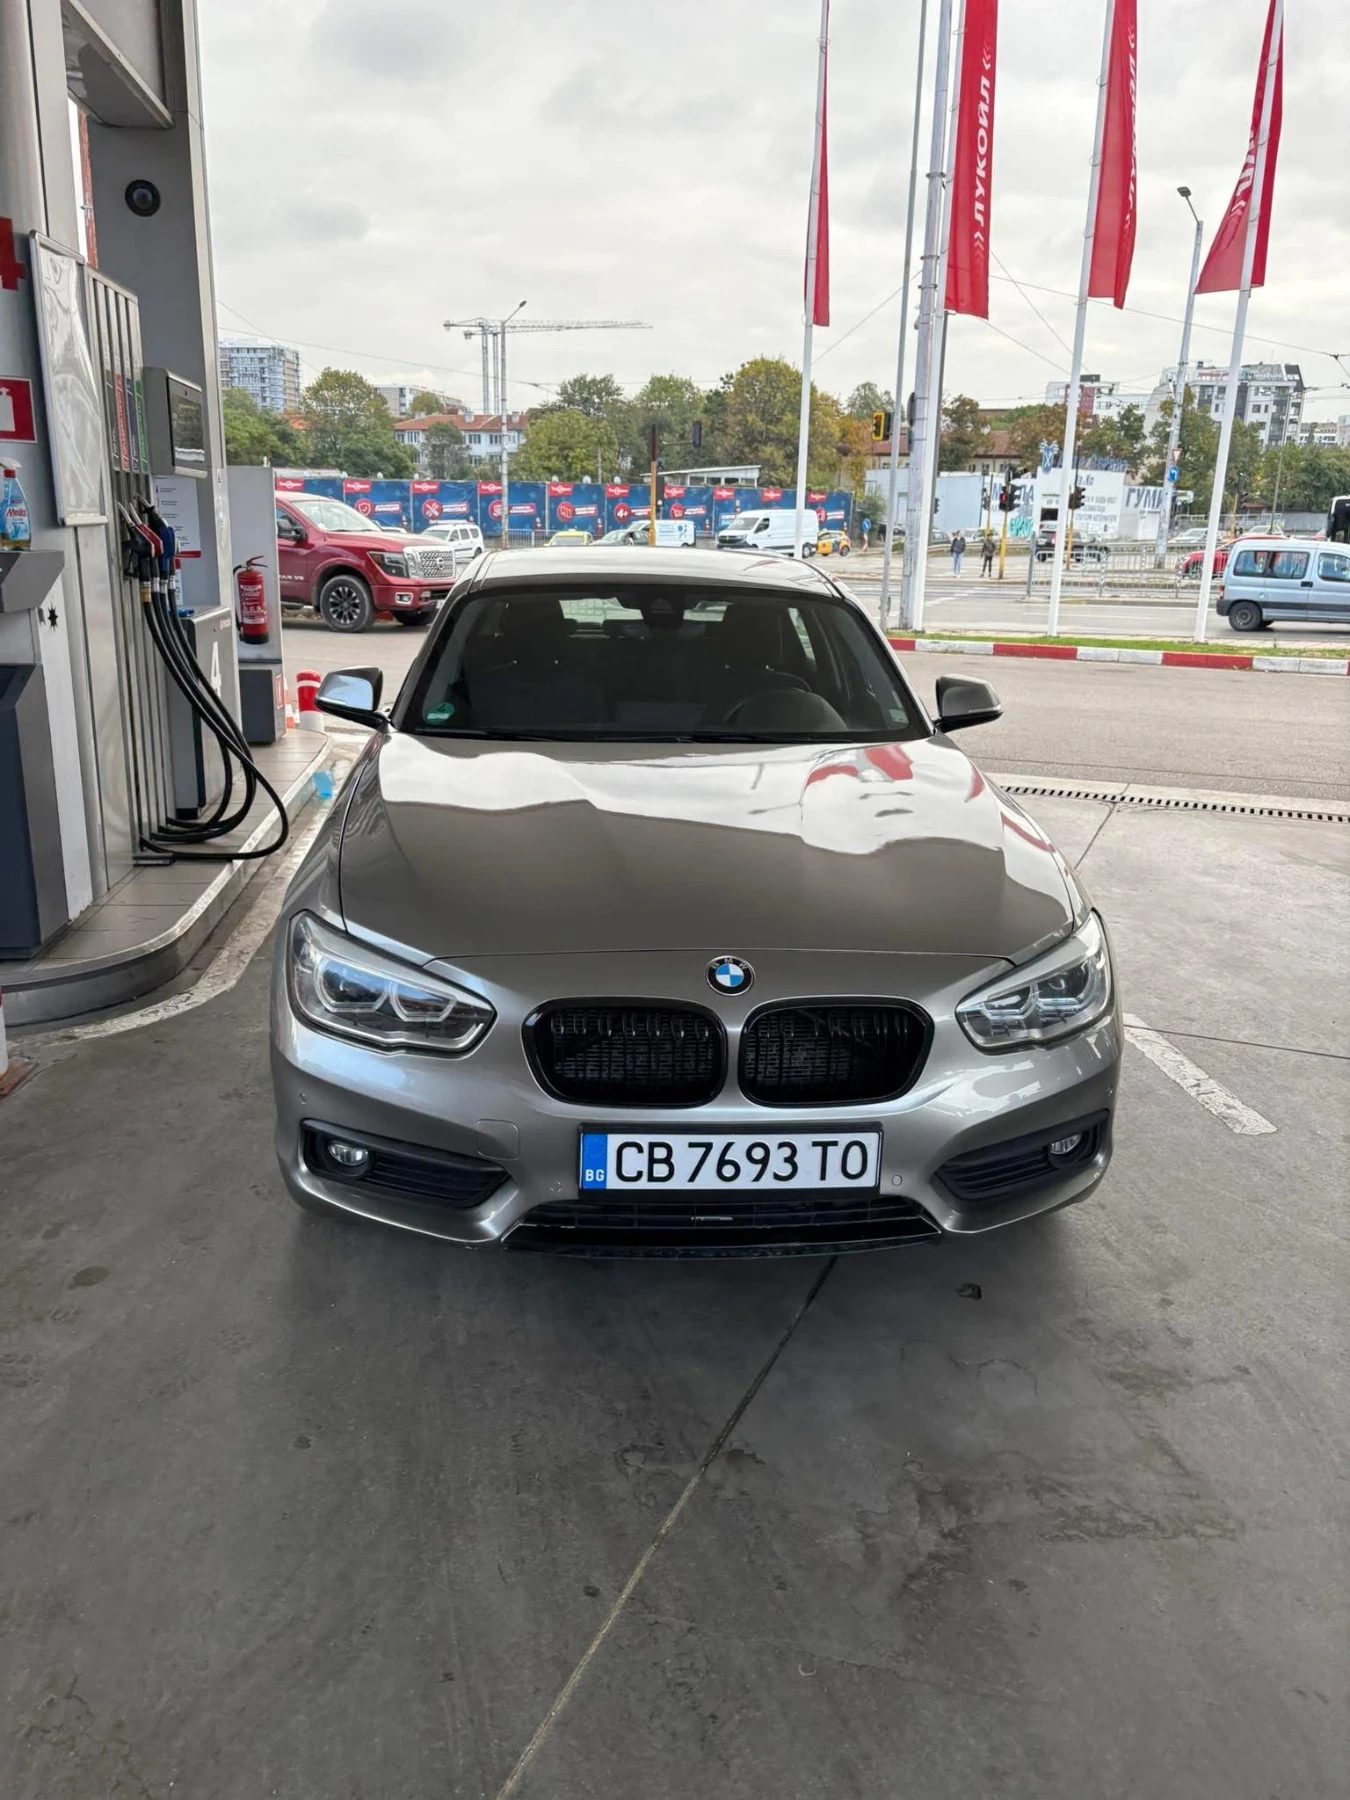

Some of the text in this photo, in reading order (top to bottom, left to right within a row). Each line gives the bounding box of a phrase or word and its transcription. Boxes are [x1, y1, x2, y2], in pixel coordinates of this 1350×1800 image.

[974, 75, 991, 226] ЛУКОЙЛ
[711, 957, 748, 970] BMW
[615, 1139, 868, 1183] CB 7693 TO
[585, 1169, 605, 1182] BG
